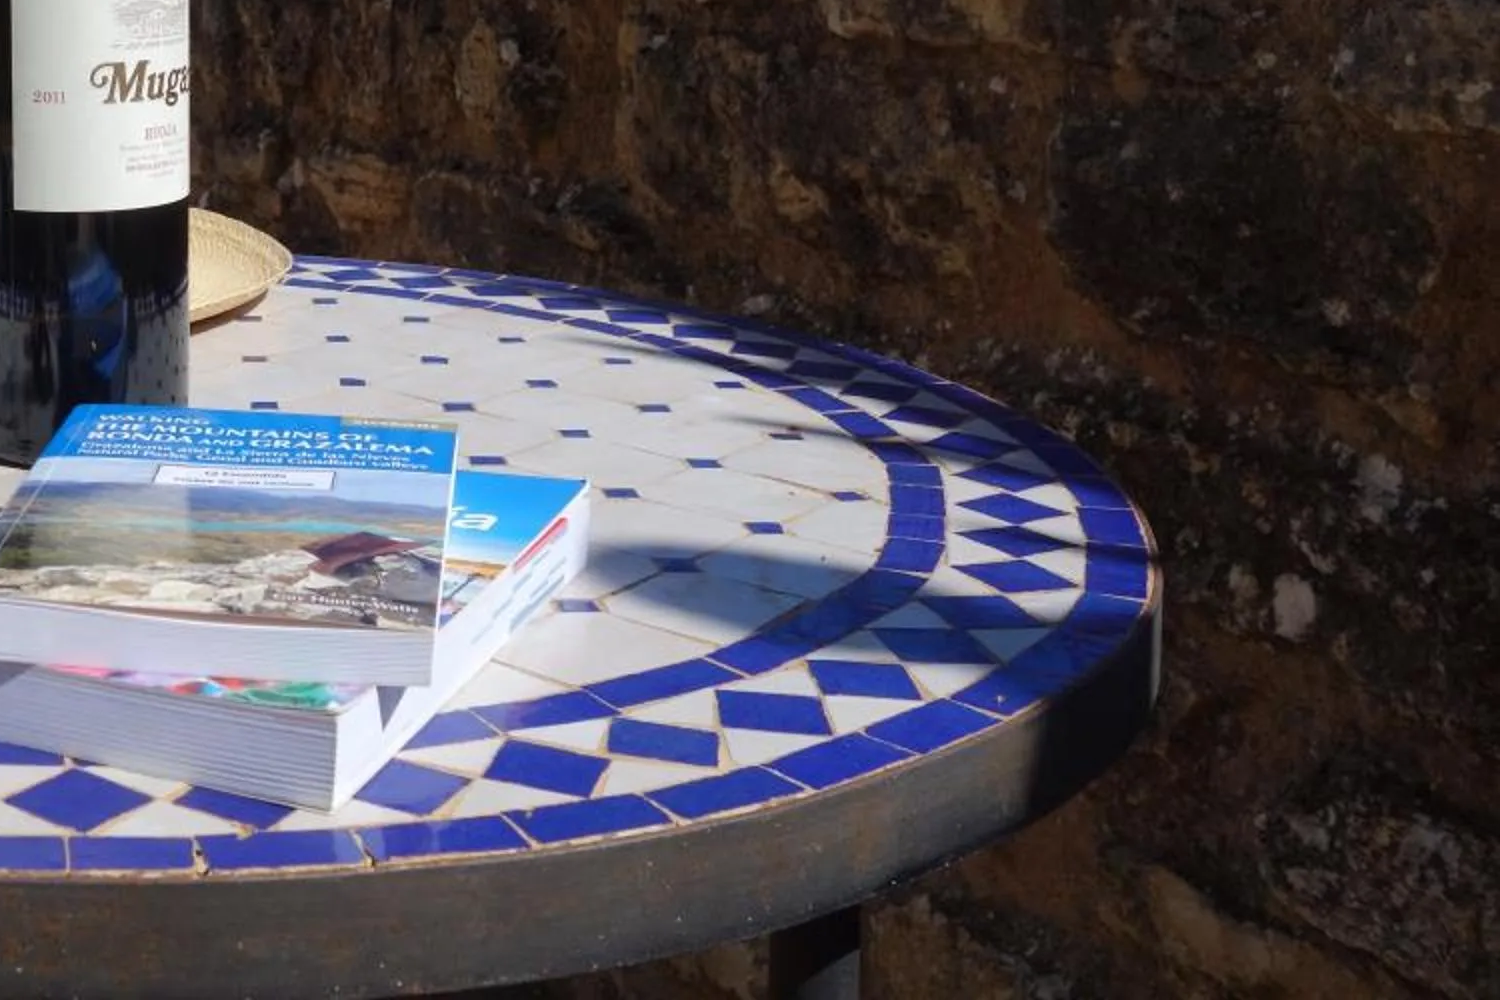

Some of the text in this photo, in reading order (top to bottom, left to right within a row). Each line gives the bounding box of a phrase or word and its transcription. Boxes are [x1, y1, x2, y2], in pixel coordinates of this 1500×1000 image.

[32, 90, 66, 104] 2011
[100, 414, 210, 425] WALKING
[96, 423, 379, 441] THE MOUNTAINS OF
[87, 431, 435, 455] RONDA AND GRAZALEMA
